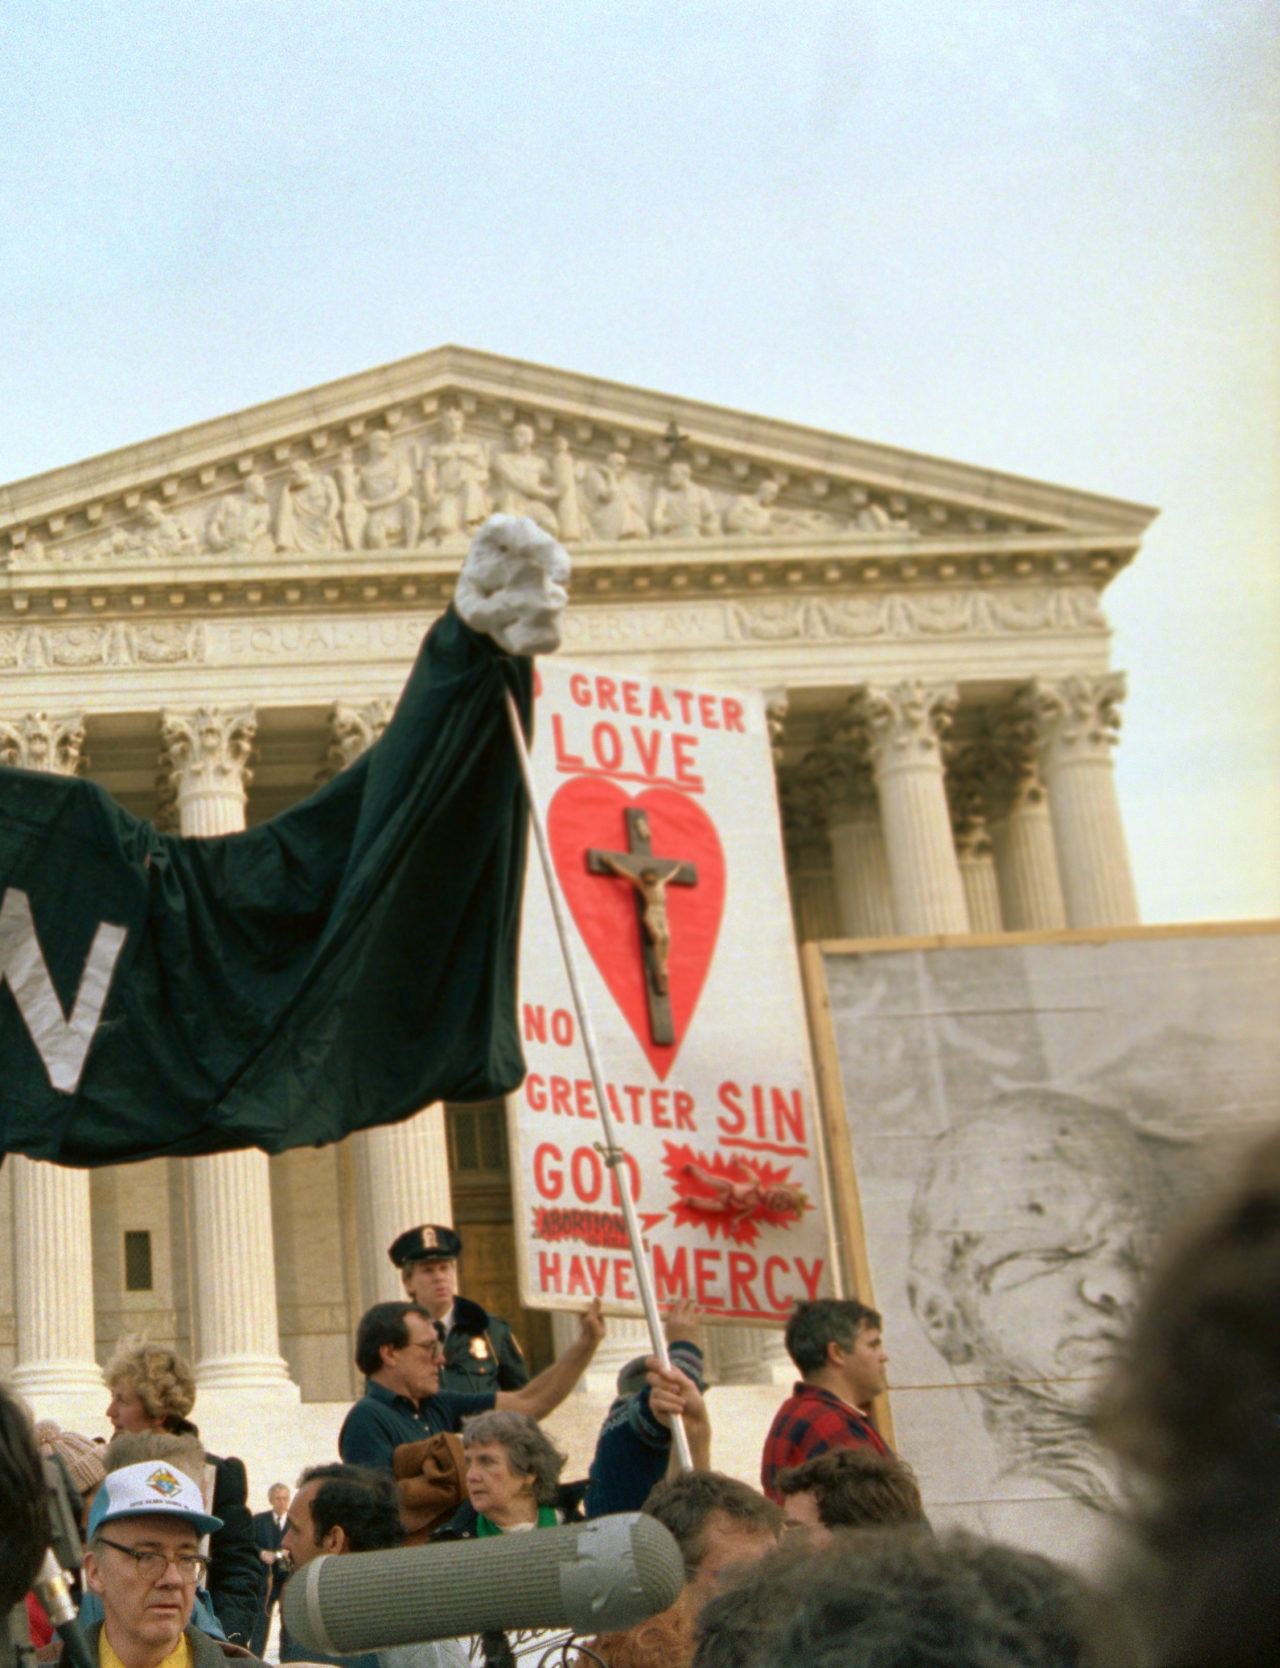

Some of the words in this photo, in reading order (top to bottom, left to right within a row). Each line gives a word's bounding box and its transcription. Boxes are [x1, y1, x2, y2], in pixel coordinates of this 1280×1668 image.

[570, 673, 746, 733] GREATER
[551, 713, 704, 785] LOVE
[523, 1003, 574, 1047] NO
[717, 1081, 806, 1144] SIN
[533, 1143, 641, 1206] GOD
[538, 1251, 635, 1300] HAVE
[651, 1244, 824, 1311] MERCY
